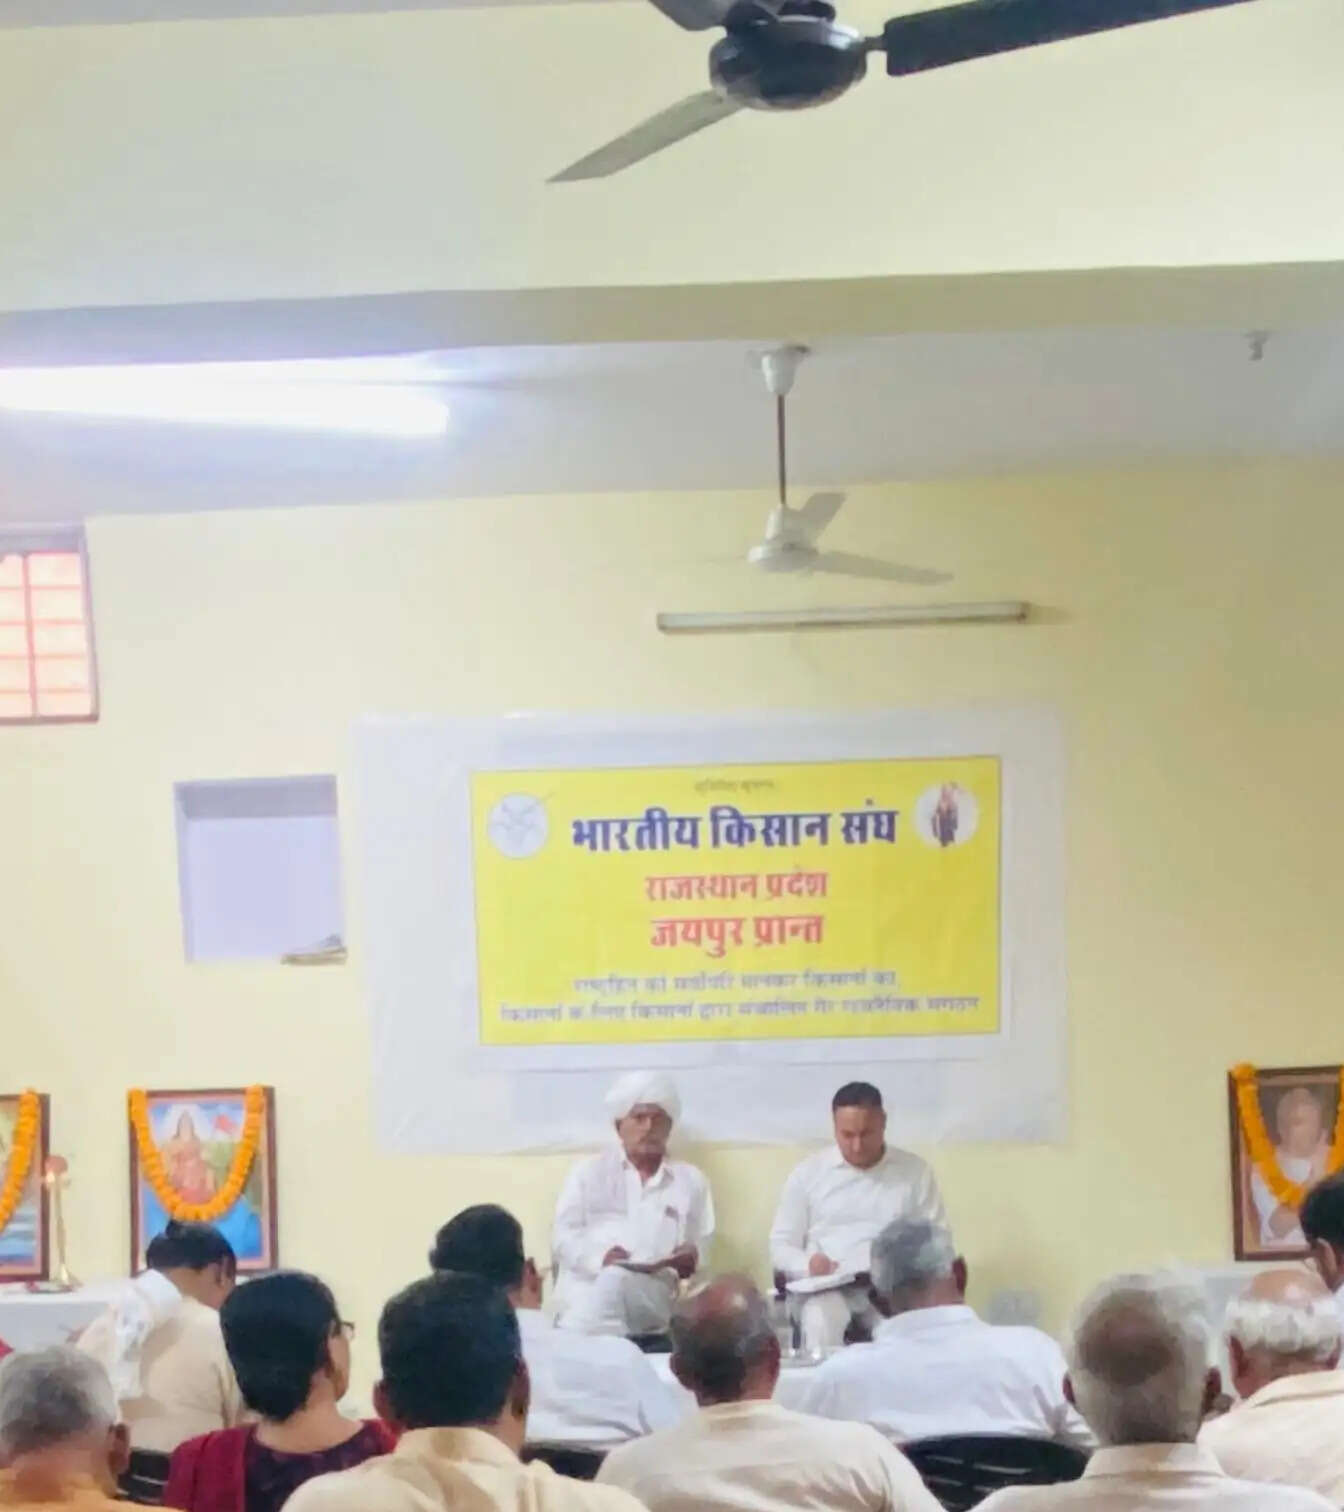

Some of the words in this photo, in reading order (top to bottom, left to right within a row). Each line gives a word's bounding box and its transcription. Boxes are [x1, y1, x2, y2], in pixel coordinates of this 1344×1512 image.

[572, 808, 703, 853] भारतीय
[710, 804, 829, 849] किसान
[840, 798, 899, 846] संघ
[645, 873, 757, 902] राजस्थान
[765, 866, 828, 901] प्रदेश
[650, 918, 744, 958] जयपुर
[753, 914, 824, 946] प्रान्त
